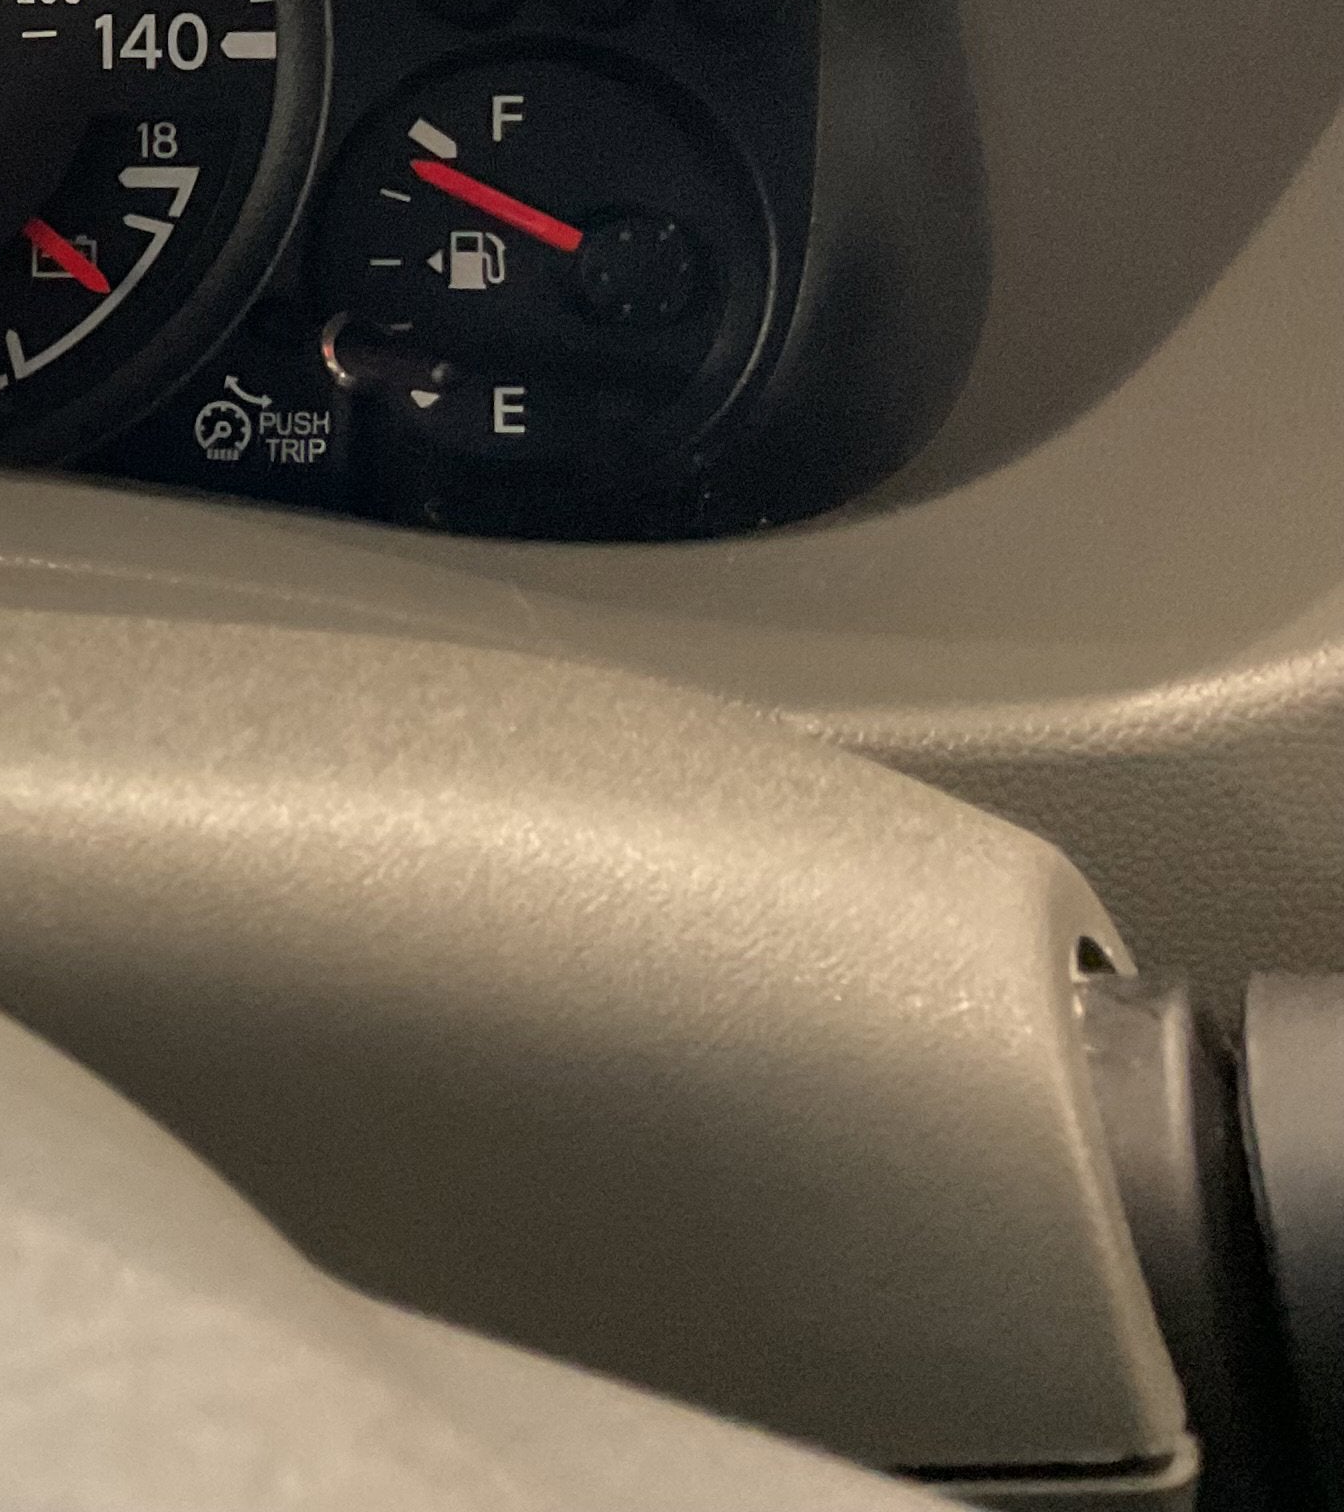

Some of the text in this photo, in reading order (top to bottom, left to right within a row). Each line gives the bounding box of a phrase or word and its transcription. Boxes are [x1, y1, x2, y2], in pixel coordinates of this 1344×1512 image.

[95, 14, 209, 71] 140
[492, 95, 524, 142] F
[137, 122, 177, 157] 18
[259, 410, 330, 435] PUSH
[492, 387, 526, 434] E
[265, 438, 327, 463] TRIP
